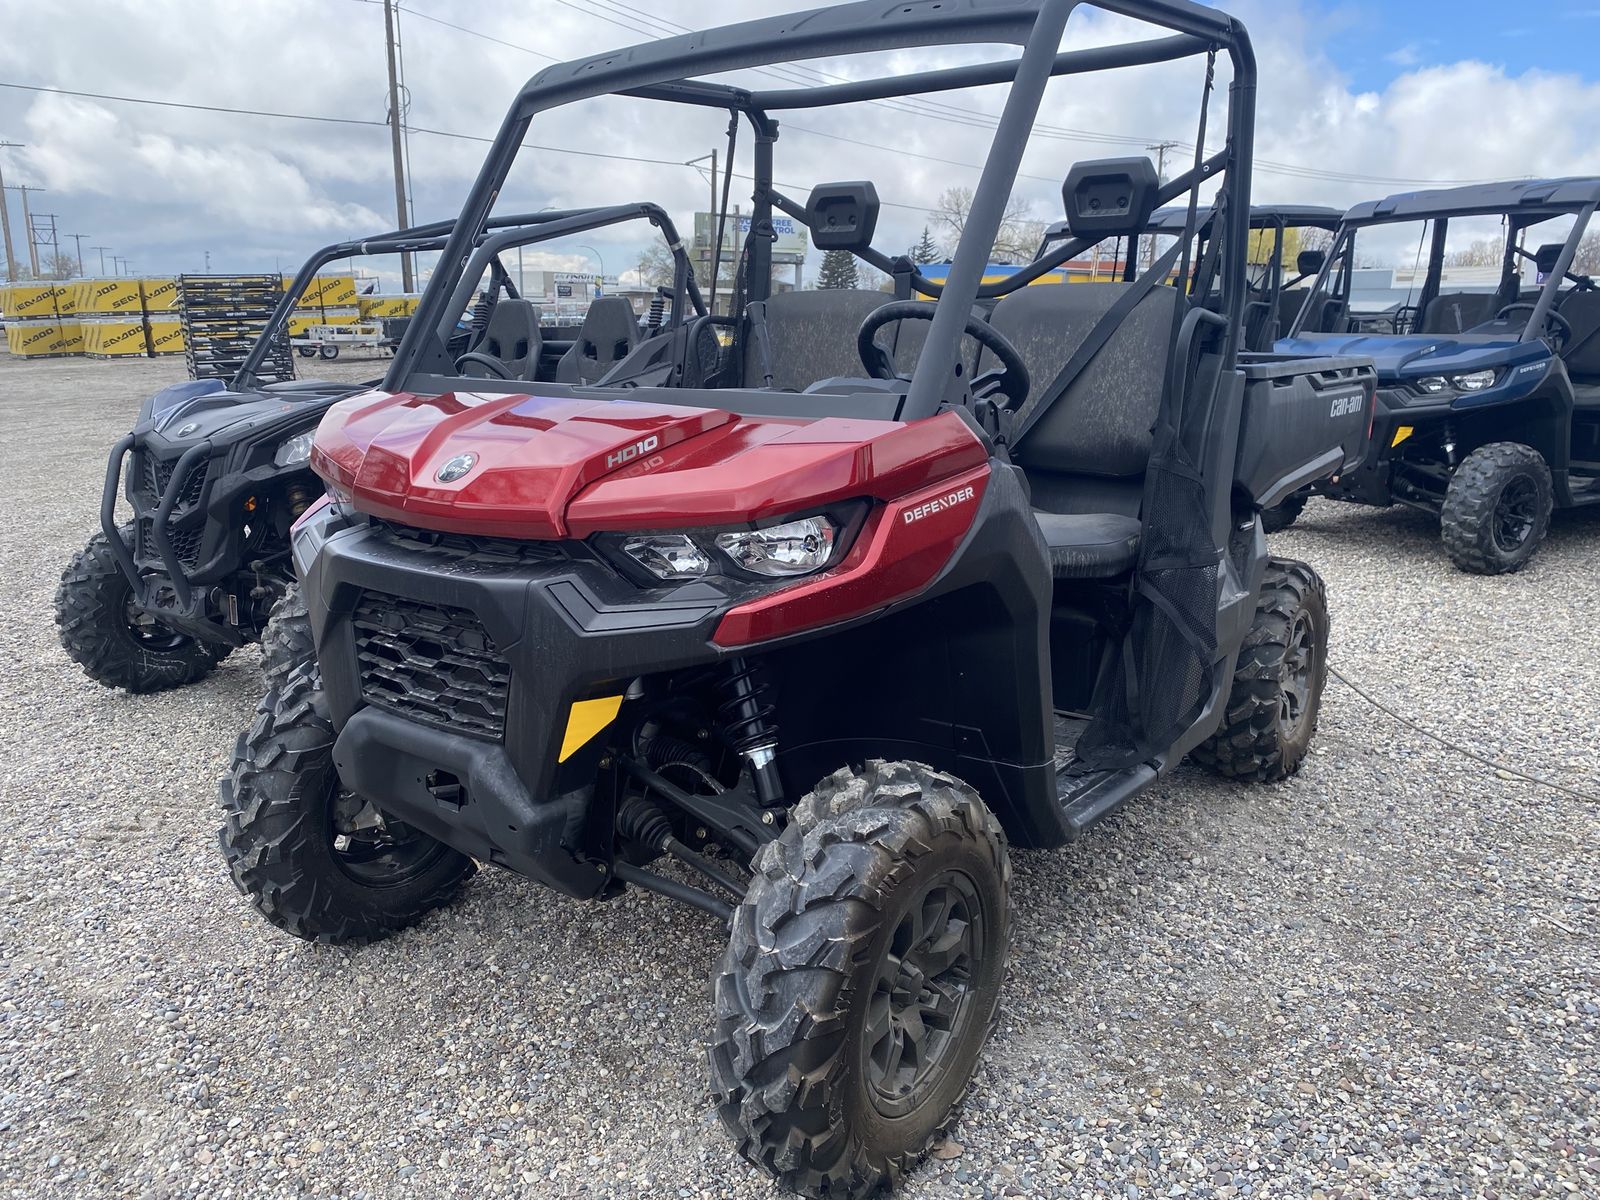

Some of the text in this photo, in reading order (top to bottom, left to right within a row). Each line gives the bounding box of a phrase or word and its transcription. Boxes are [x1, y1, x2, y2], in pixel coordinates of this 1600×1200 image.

[1519, 362, 1546, 374] DEFENDER
[1330, 394, 1363, 418] can-am
[607, 435, 658, 469] HD10
[903, 486, 975, 524] DEFENDER
